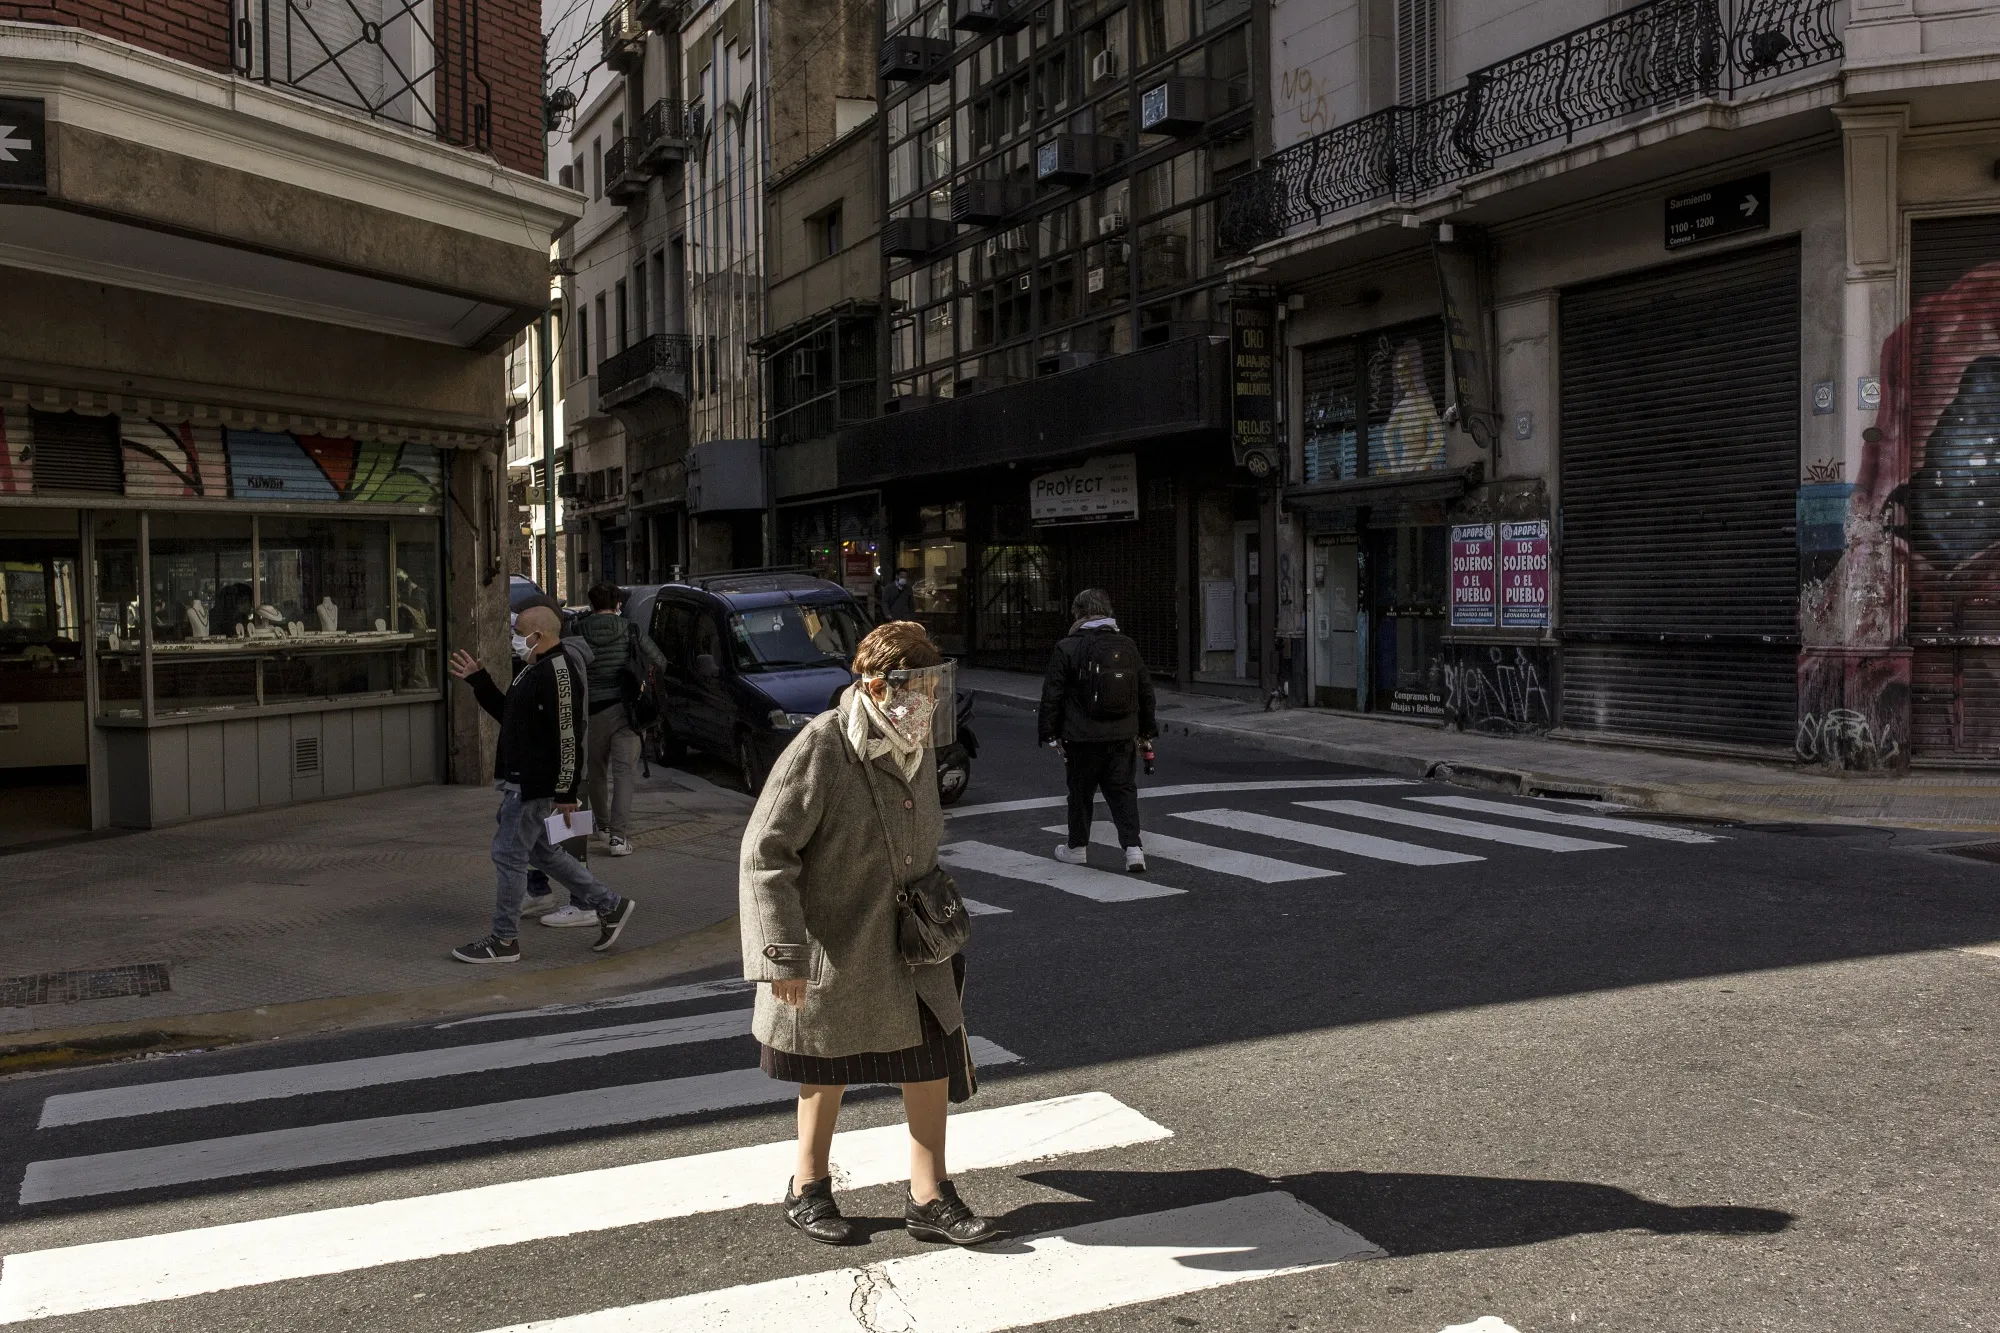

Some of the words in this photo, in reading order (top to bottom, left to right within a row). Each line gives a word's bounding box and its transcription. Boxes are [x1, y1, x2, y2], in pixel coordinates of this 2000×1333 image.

[1669, 192, 1712, 210] Sarmiento
[1670, 221, 1689, 234] 1100
[1696, 215, 1715, 229] 1200
[1669, 236, 1691, 245] Comuna
[1692, 233, 1696, 241] 1
[1242, 329, 1264, 348] ORO
[1236, 354, 1271, 368] ALHAJAS
[1236, 383, 1272, 396] BRILLANTES
[1237, 420, 1271, 435] RELOJES
[1248, 458, 1267, 473] ORO
[1035, 475, 1103, 497] PROYECT
[1462, 527, 1484, 538] APOPS
[1513, 525, 1536, 536] APOPS
[1465, 543, 1480, 555] LOS
[1517, 541, 1532, 553] LOS
[1454, 556, 1493, 572] SOJEROS
[1504, 555, 1547, 571] SOJEROS
[1463, 576, 1469, 586] O
[1471, 575, 1480, 586] EL
[1514, 575, 1520, 586] O
[1523, 575, 1532, 586] EL
[1456, 588, 1491, 602] PUEBLO
[1506, 588, 1545, 603] PUEBLO
[556, 668, 571, 699] BROSS
[1394, 691, 1428, 702] Compramos
[1429, 693, 1441, 702] Oro
[559, 700, 573, 731] JEANS
[1390, 702, 1411, 713] Alhajas
[1416, 704, 1445, 715] Brillantes
[561, 736, 575, 765] BROSS
